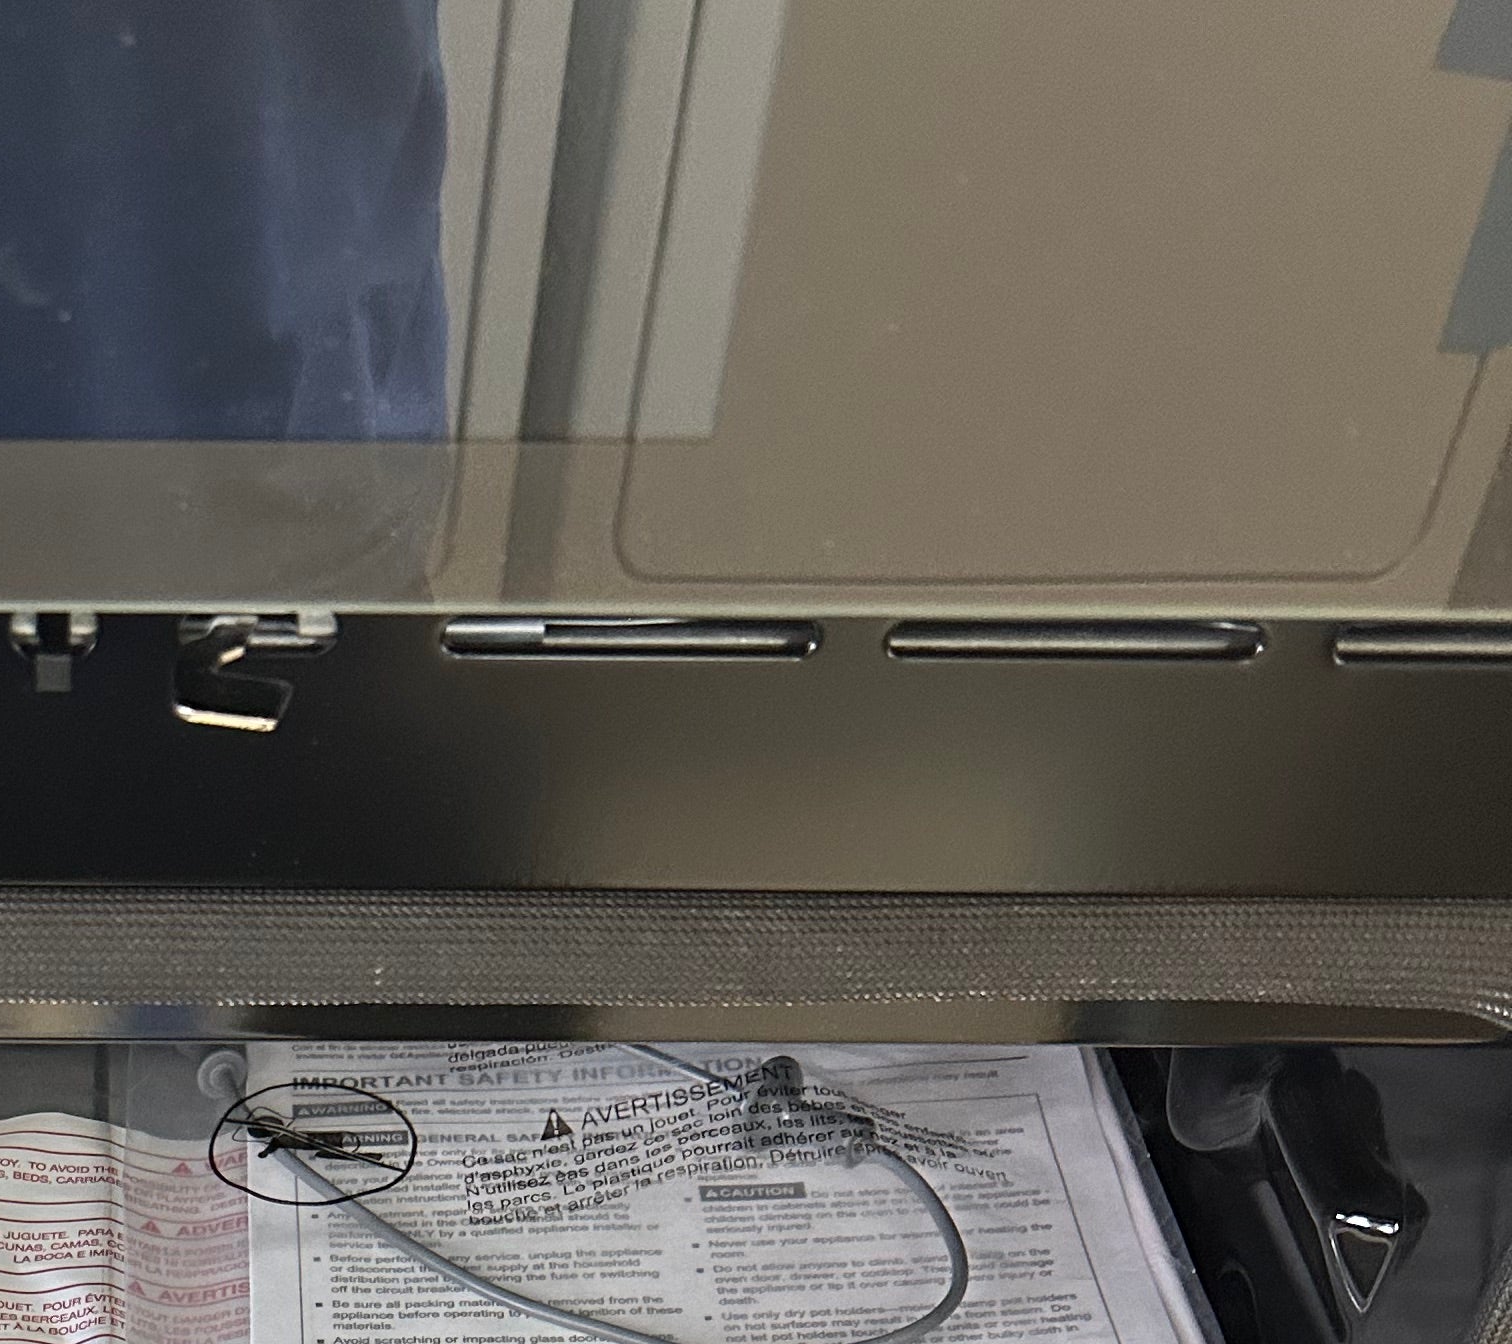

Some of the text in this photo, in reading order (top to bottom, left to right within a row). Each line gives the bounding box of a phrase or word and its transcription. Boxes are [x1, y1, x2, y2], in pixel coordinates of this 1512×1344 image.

[292, 1068, 563, 1092] IMPORTANT SAFETY
[582, 1066, 788, 1128] AVERTISSEMENT
[461, 1151, 488, 1168] Ce
[493, 1148, 527, 1164] sac
[530, 1137, 577, 1158] n'est
[581, 1131, 616, 1151] pas
[620, 1124, 647, 1139] un
[706, 1087, 749, 1110] Pour
[27, 1160, 46, 1171] TO
[48, 1163, 89, 1173] AVOID
[92, 1165, 118, 1176] THE
[715, 1186, 795, 1199] CAUTION
